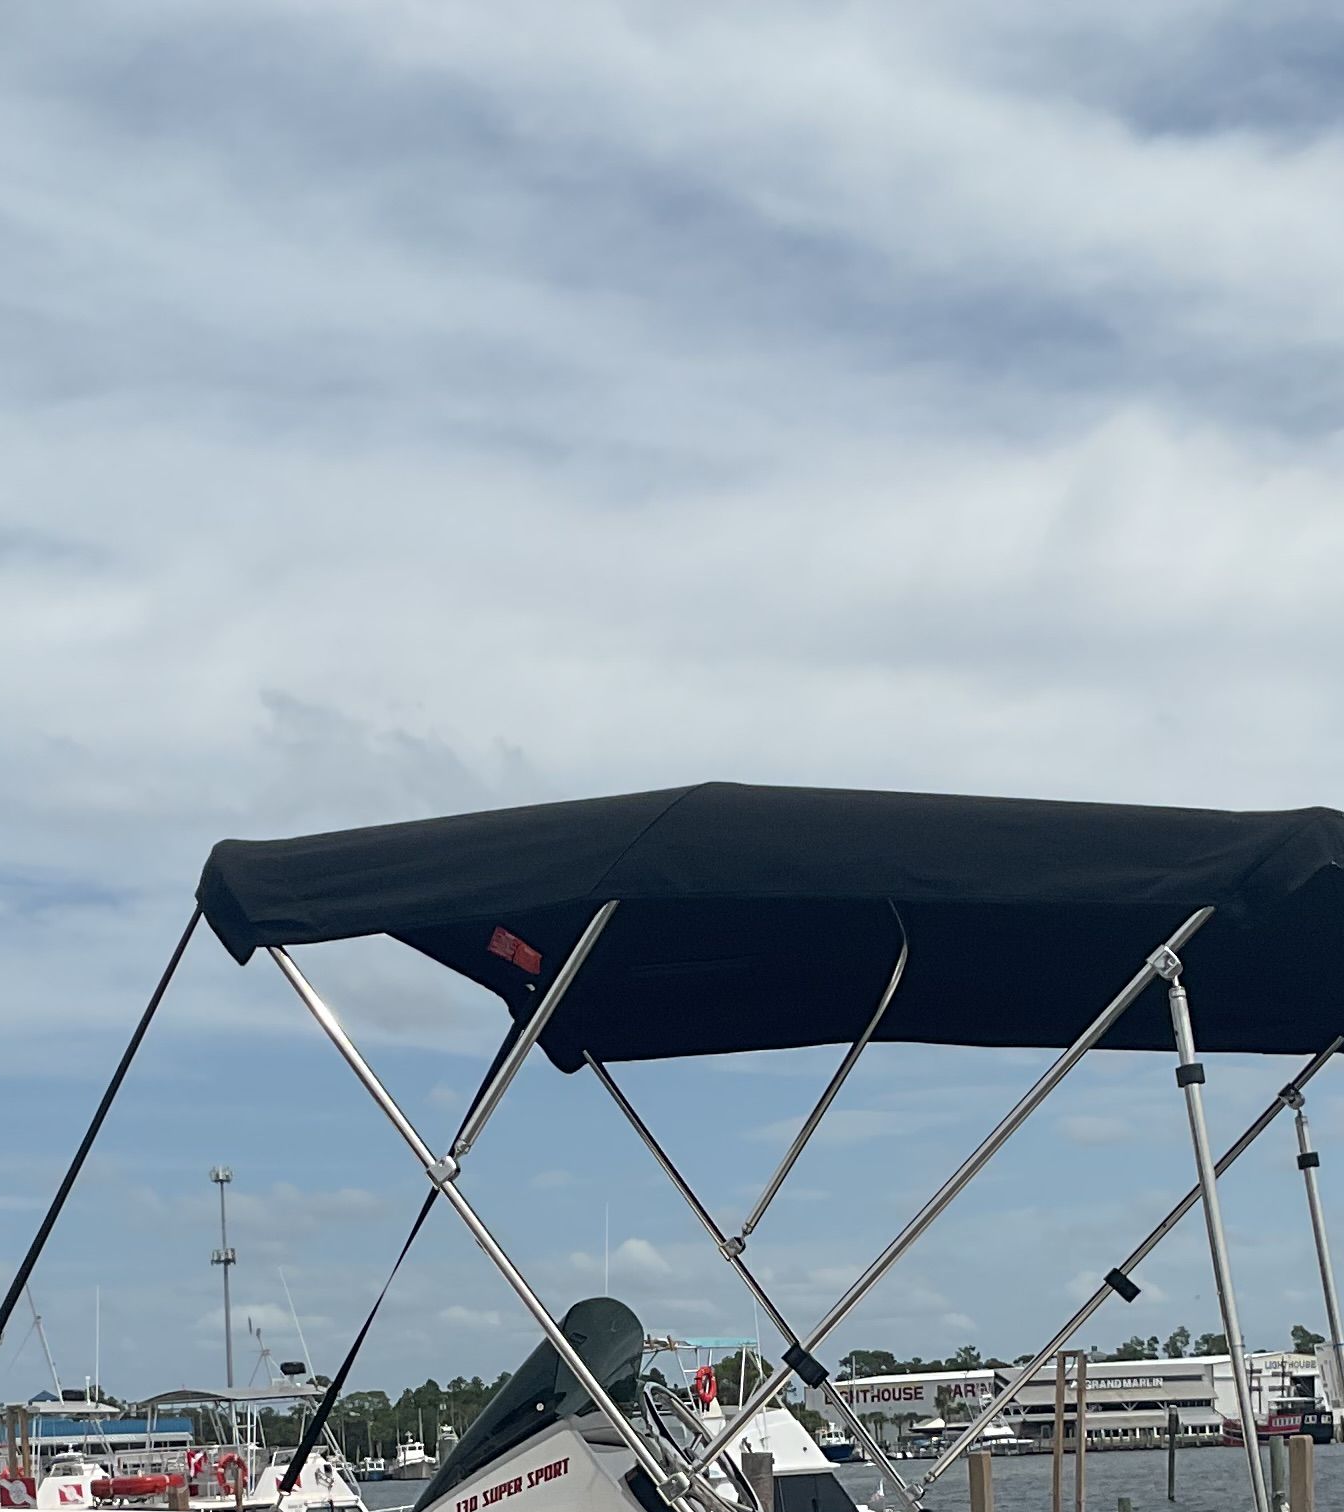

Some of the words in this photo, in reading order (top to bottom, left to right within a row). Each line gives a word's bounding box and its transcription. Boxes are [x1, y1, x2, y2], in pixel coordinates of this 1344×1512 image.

[1264, 1360, 1317, 1370] LIGHTHOUSE
[1085, 1380, 1122, 1390] GRAND
[1122, 1377, 1163, 1389] MARLIN
[825, 1386, 924, 1405] LGHTHOUSE
[481, 1476, 523, 1508] SUPER
[527, 1457, 570, 1489] SPORT
